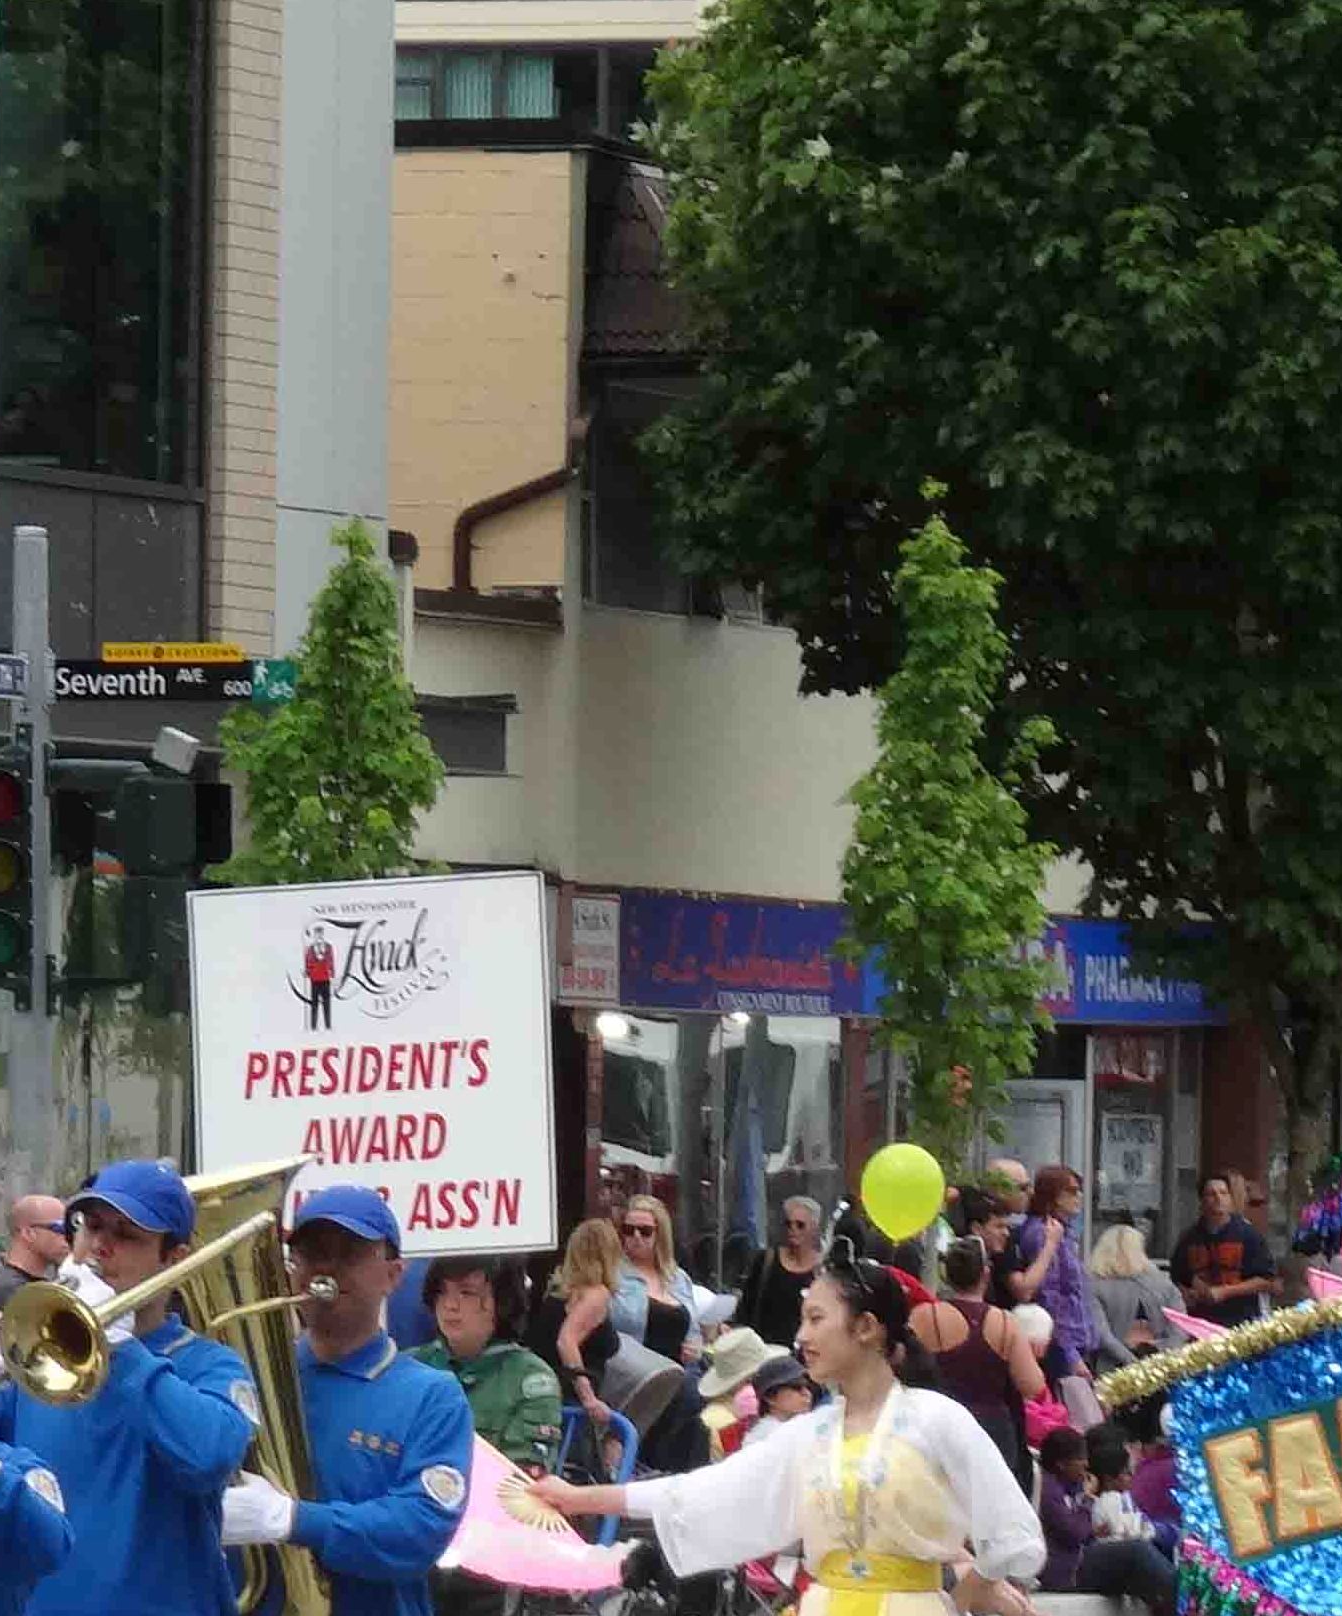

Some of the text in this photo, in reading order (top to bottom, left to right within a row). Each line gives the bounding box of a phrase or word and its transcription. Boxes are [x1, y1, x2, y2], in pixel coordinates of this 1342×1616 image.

[56, 666, 166, 697] Seventh
[223, 680, 252, 697] 600
[244, 1038, 491, 1100] PRESIDENT'S
[302, 1113, 448, 1165] AWARD
[407, 1179, 522, 1232] ASS'N
